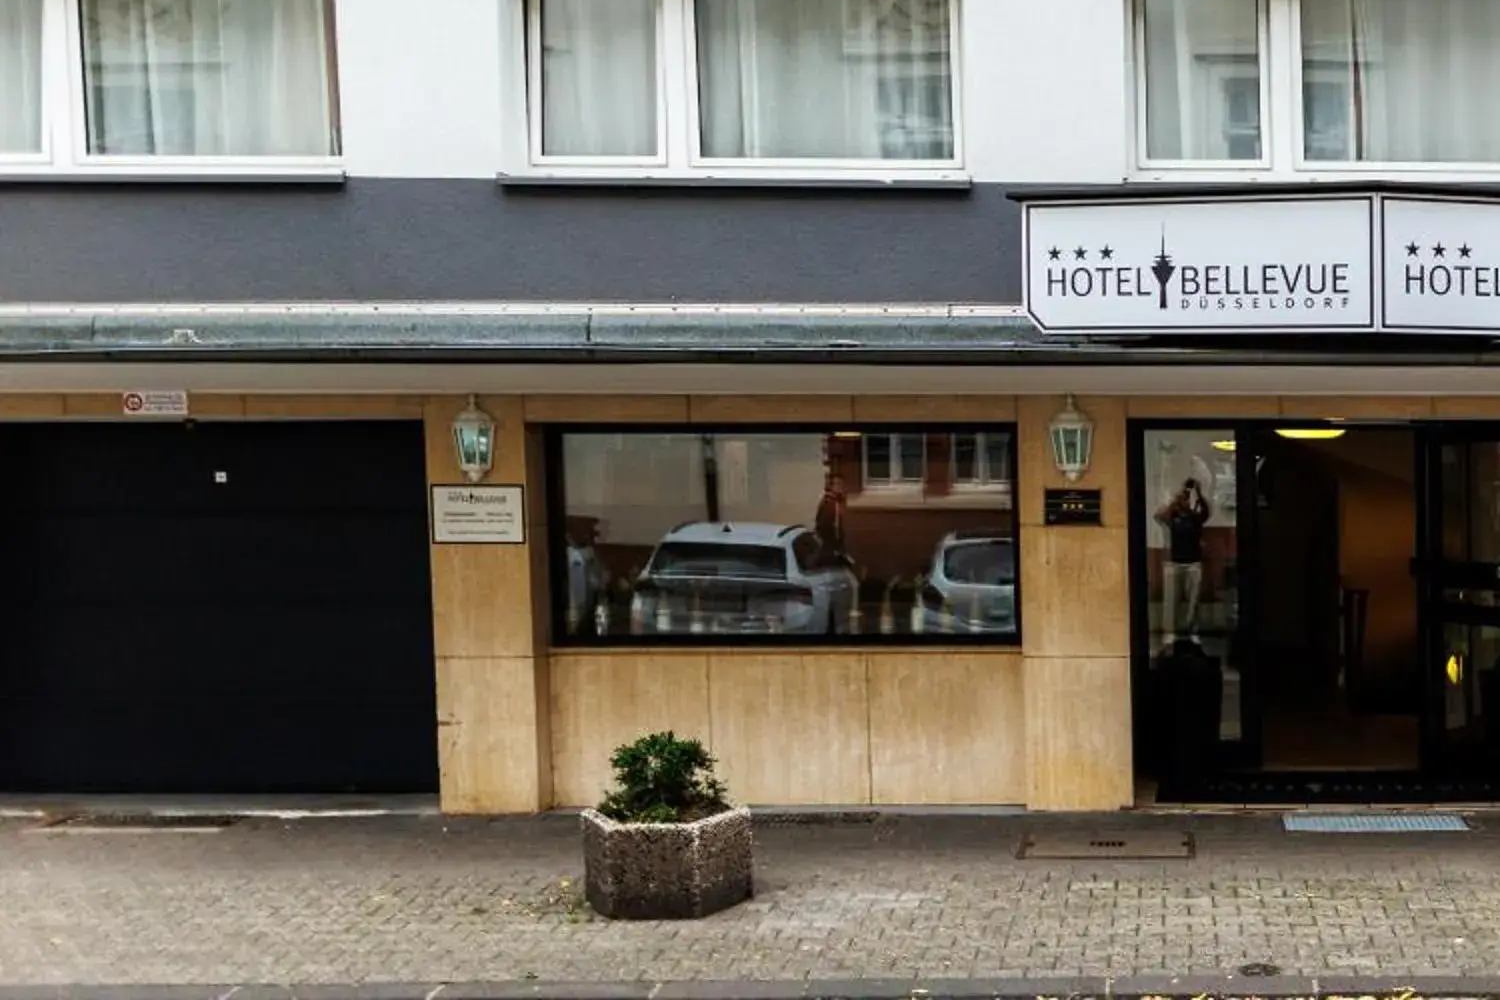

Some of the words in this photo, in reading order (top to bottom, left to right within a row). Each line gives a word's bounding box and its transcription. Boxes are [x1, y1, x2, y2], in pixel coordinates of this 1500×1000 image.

[1046, 266, 1153, 298] HOTEL
[1180, 263, 1350, 296] BELLEVUE
[1180, 295, 1350, 310] DÜSSELDORF
